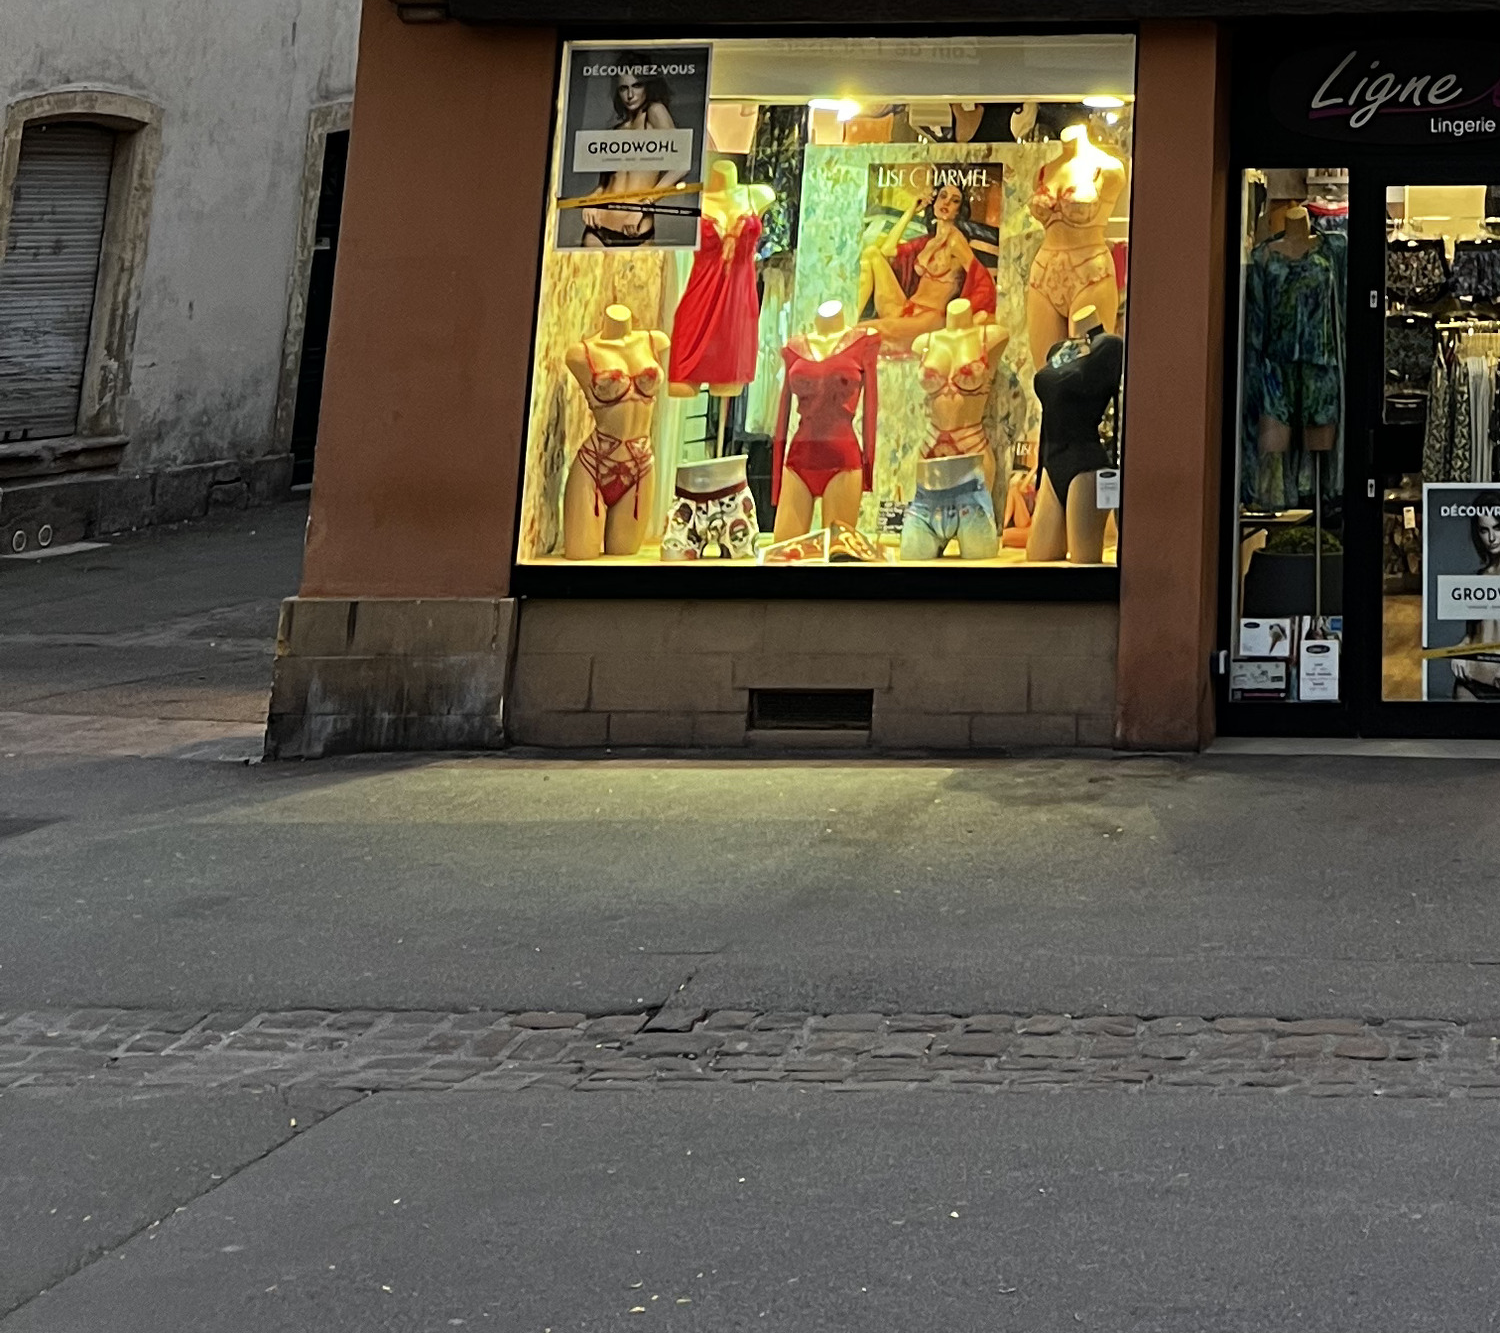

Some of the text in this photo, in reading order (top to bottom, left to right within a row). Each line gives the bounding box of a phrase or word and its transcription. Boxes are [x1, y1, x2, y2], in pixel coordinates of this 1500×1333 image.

[582, 64, 696, 77] DÉCOUVREZ-VOUS
[1310, 50, 1463, 129] Ligne
[1430, 116, 1497, 137] Lingerie
[587, 140, 679, 154] GRODWOHL
